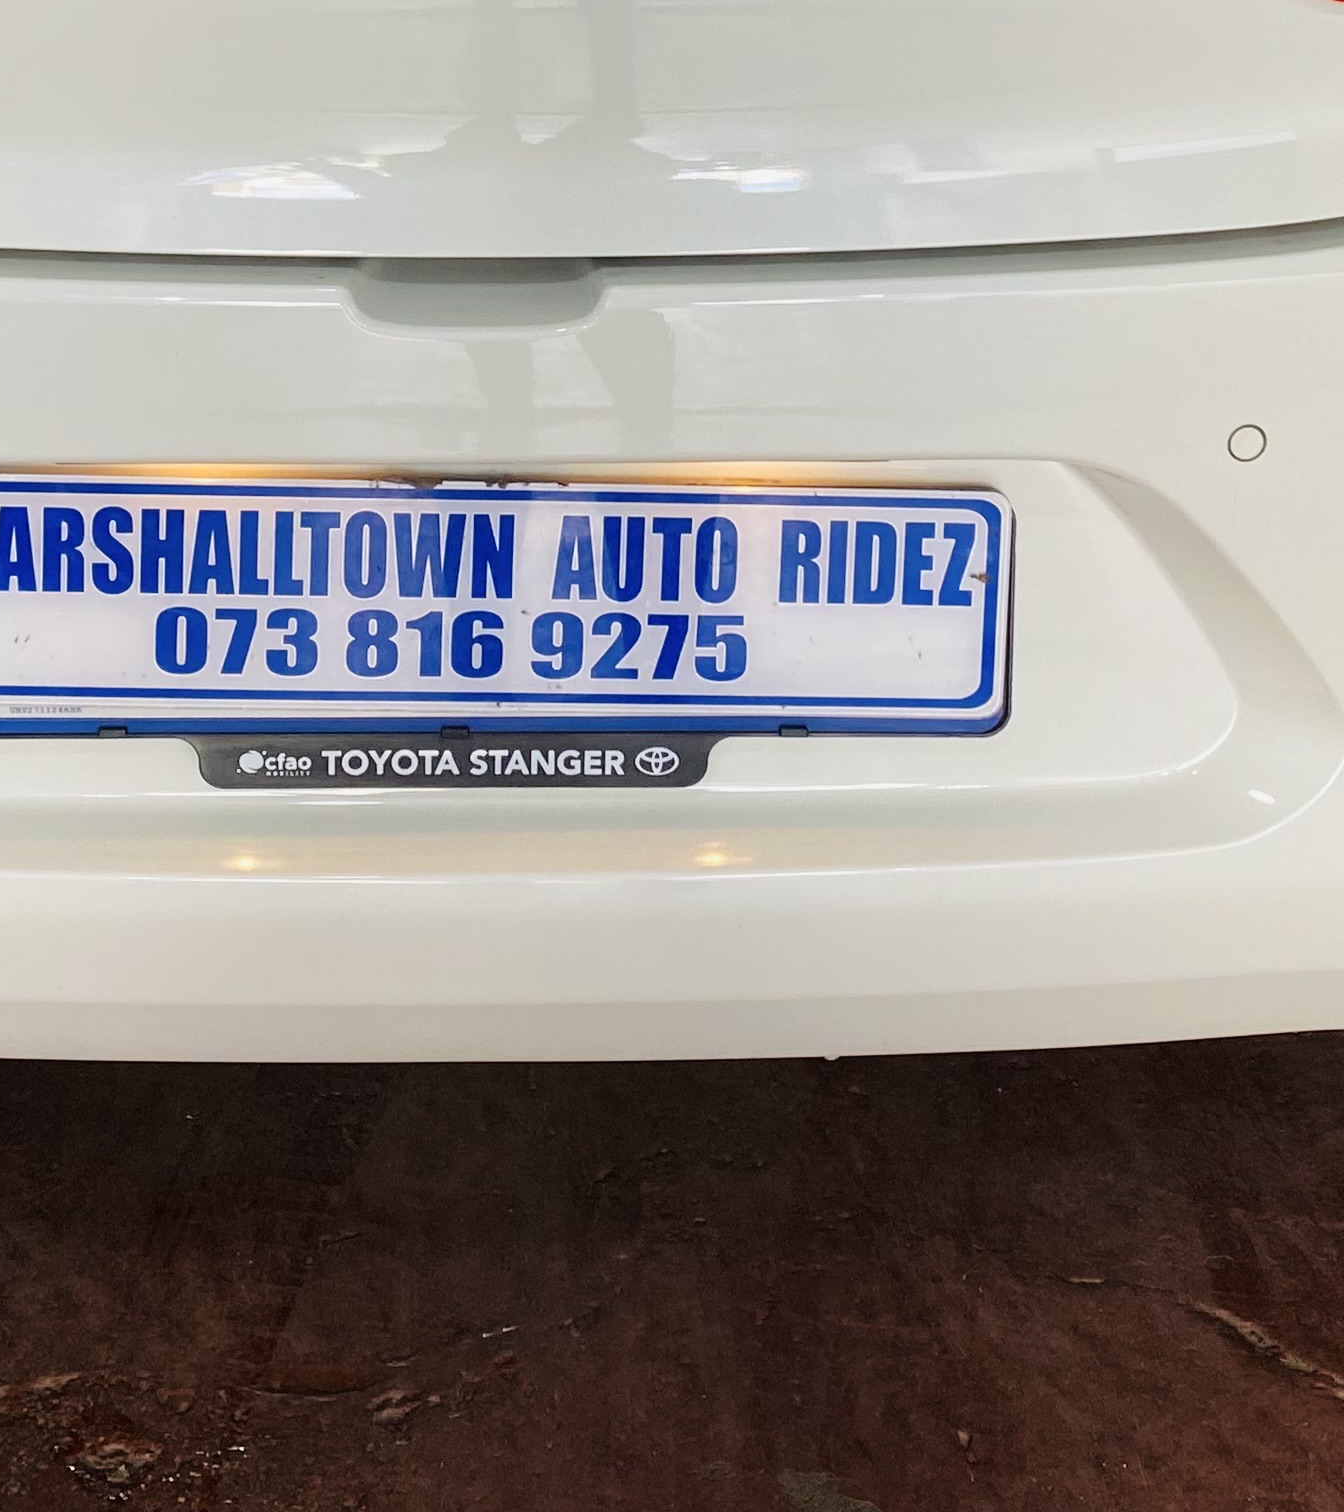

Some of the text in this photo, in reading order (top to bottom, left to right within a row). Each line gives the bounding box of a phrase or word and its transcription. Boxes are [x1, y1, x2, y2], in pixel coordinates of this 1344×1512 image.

[551, 514, 738, 604] AUTO
[778, 519, 976, 607] RIDEZ
[155, 606, 747, 681] 073 816 9275
[264, 748, 625, 776] cfao TOYOTA STANGER
